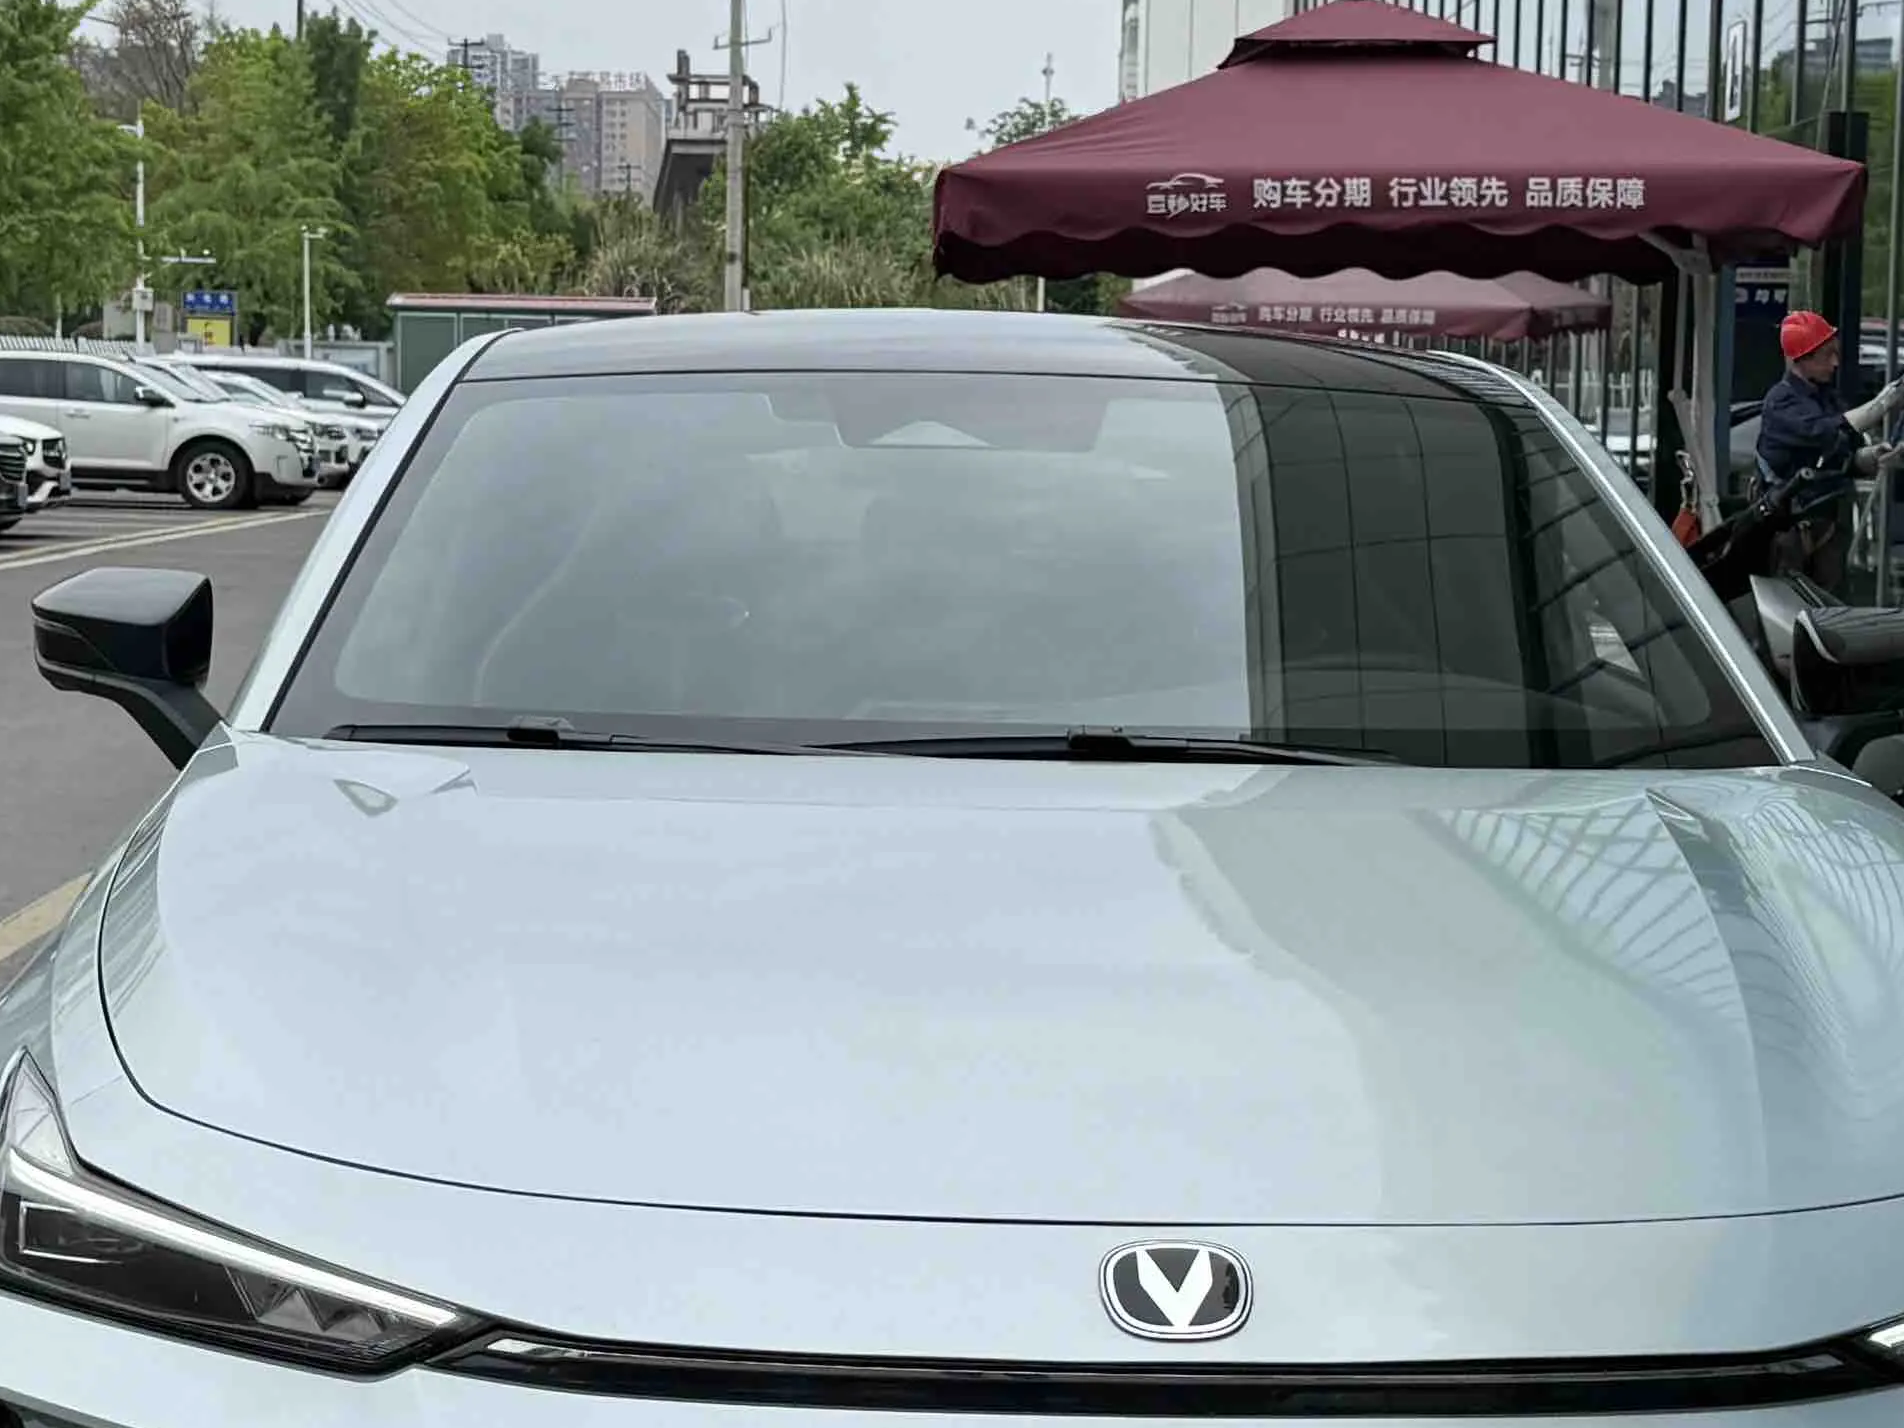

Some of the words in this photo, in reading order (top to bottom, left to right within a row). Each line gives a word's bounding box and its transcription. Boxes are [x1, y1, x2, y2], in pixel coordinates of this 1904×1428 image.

[1253, 177, 1372, 209] 购车分期
[1388, 176, 1509, 208] 行业领先
[1525, 176, 1646, 209] 品质保障
